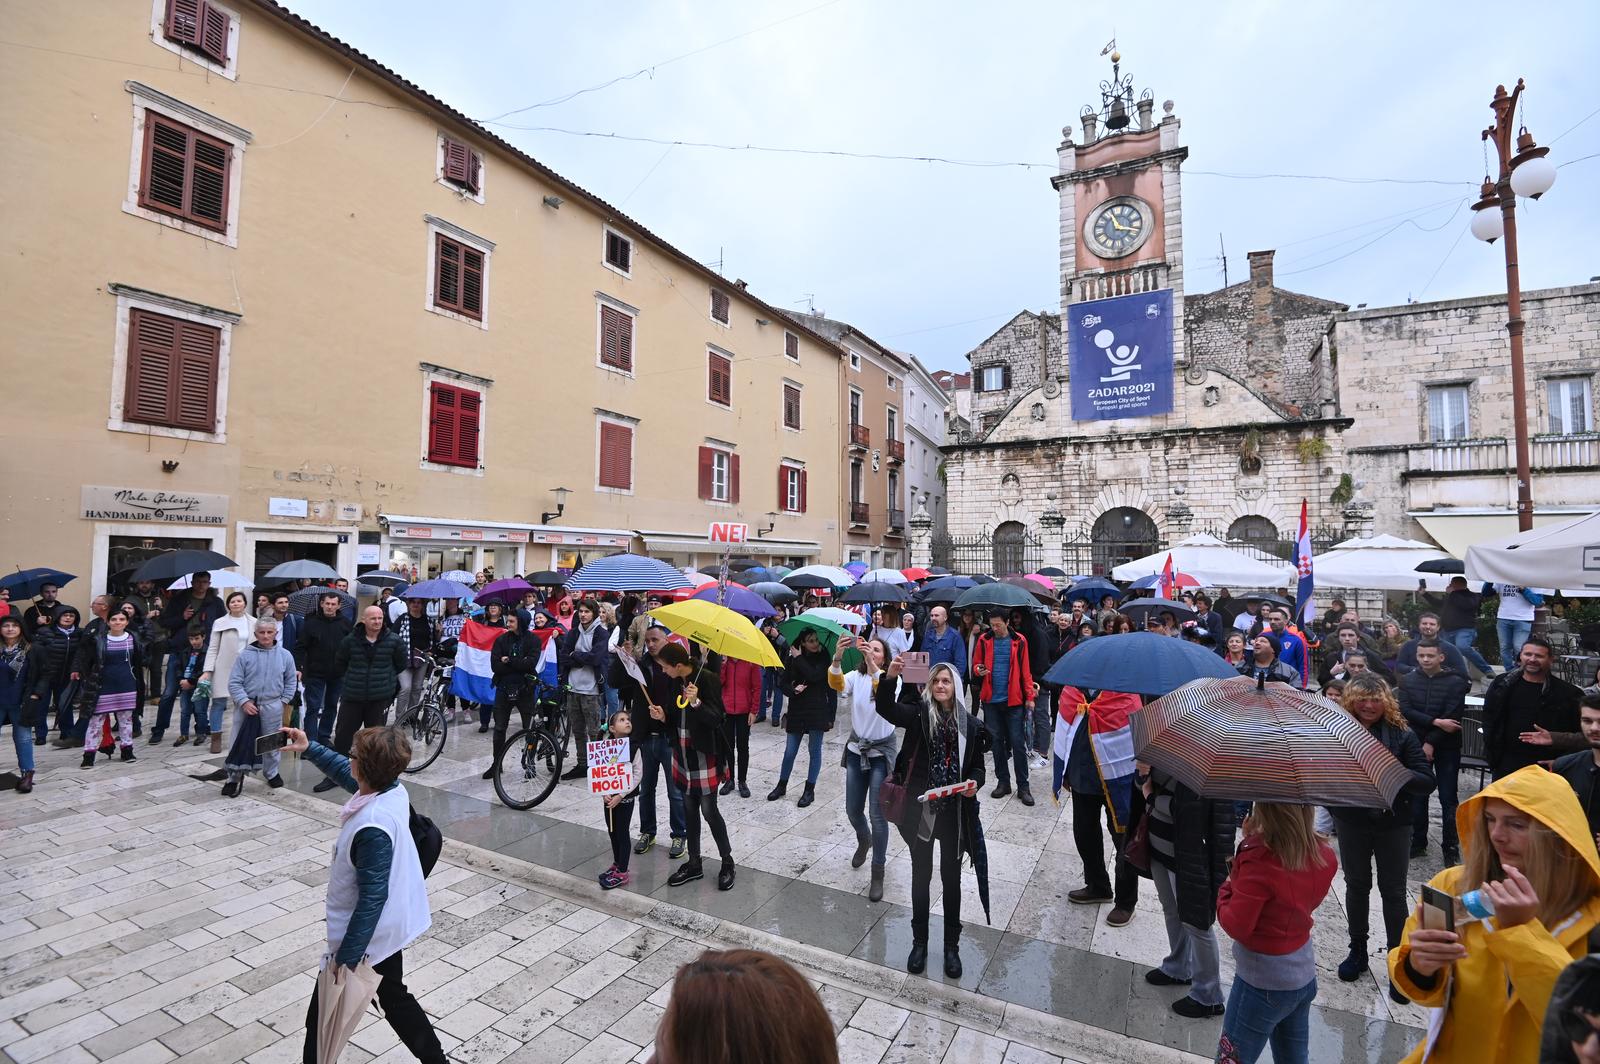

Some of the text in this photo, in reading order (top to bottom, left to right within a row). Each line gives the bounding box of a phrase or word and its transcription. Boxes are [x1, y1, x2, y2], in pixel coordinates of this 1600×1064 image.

[86, 510, 224, 524] HANDMADE JEWELLERY
[711, 523, 747, 543] NE!
[589, 750, 606, 760] DATI
